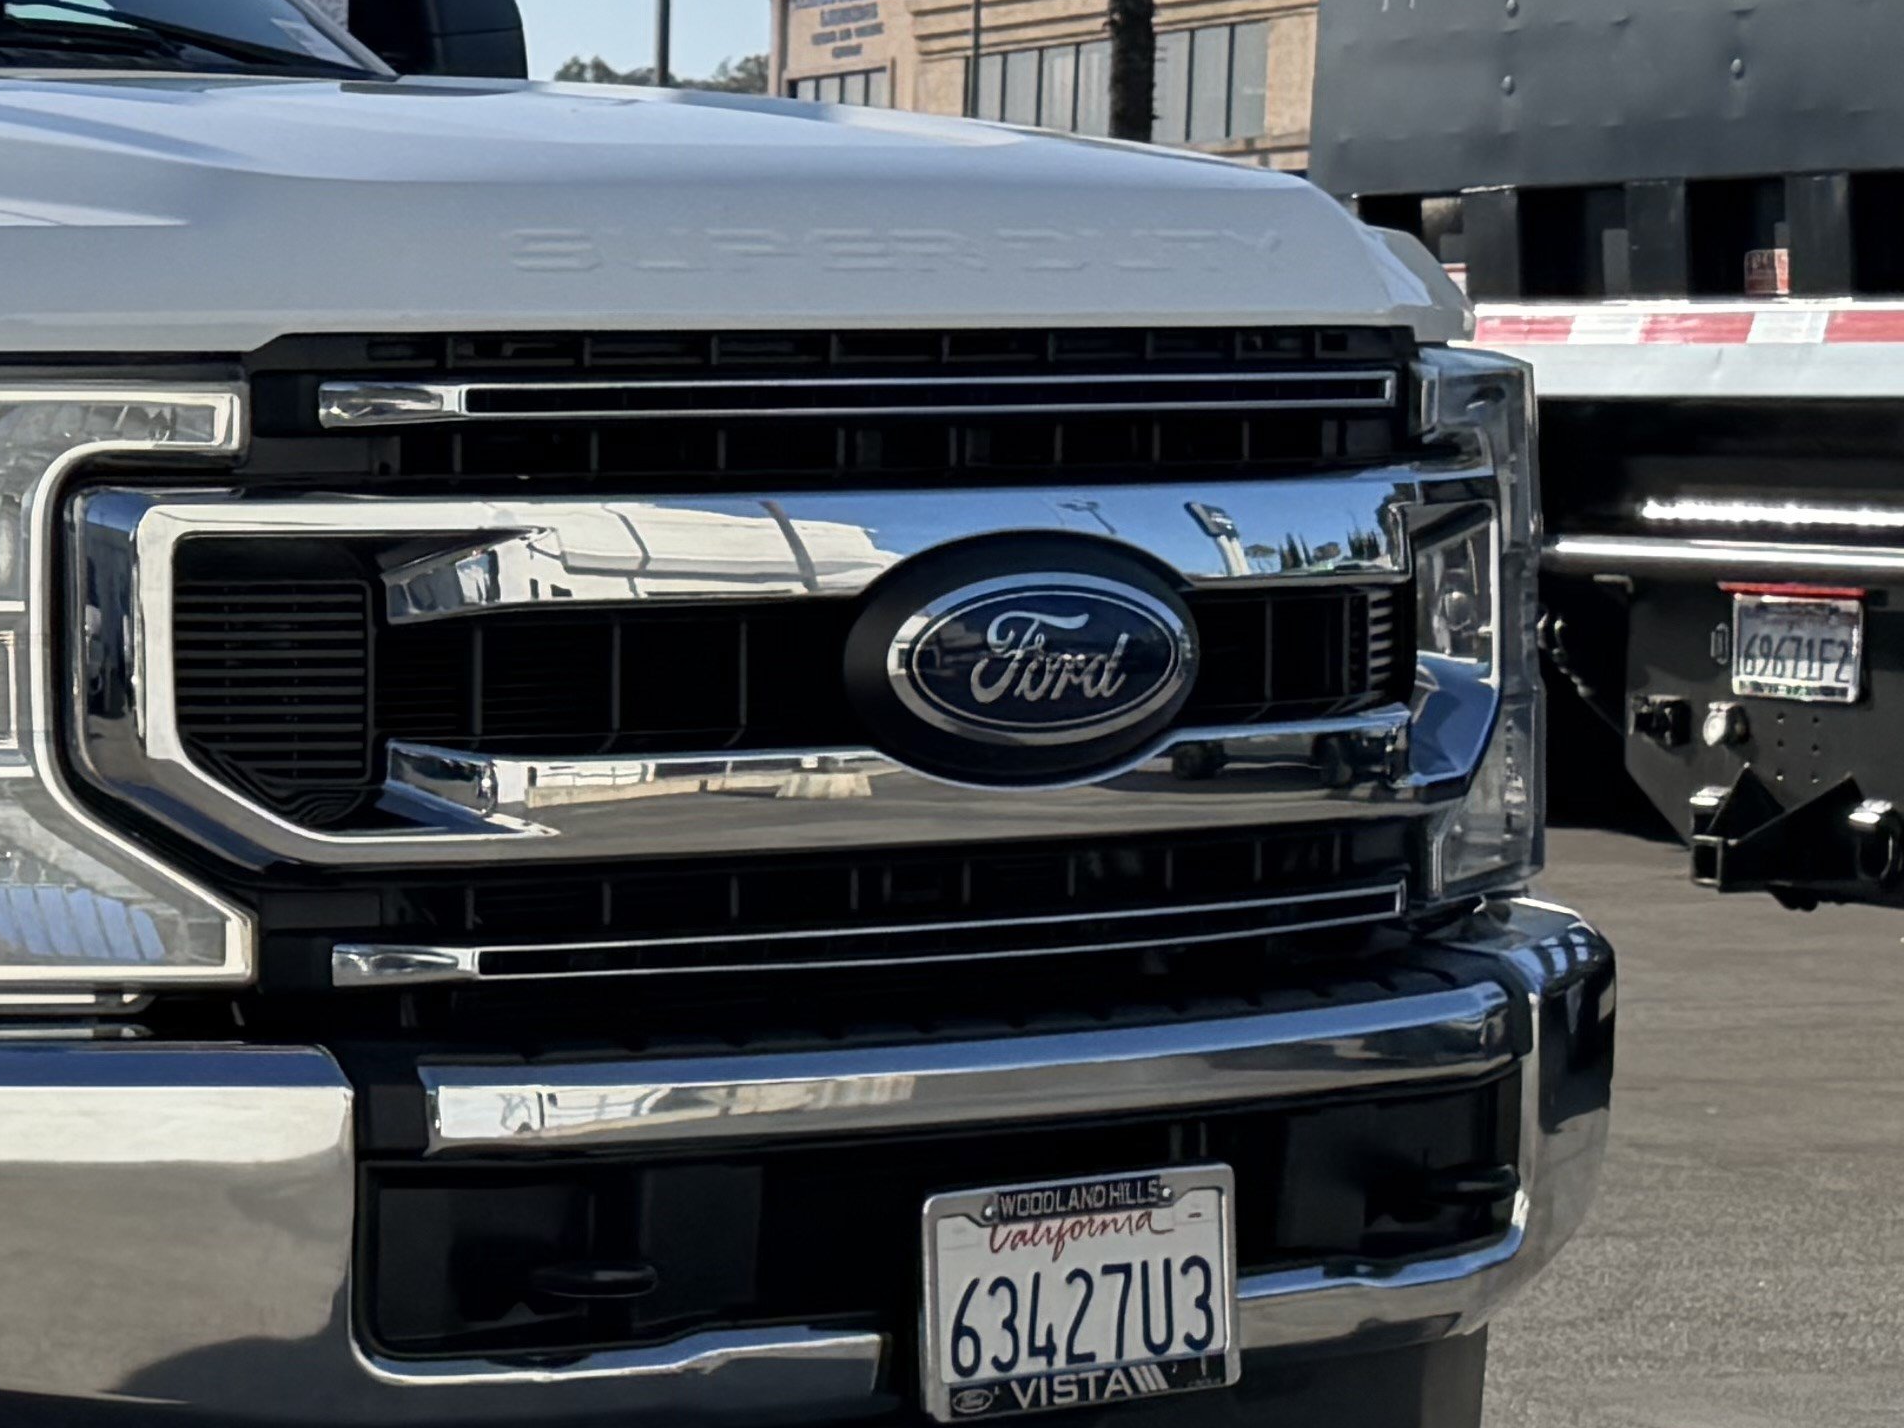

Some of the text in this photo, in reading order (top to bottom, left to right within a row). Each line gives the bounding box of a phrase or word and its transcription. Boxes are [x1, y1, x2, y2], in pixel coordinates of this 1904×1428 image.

[969, 610, 1131, 704] Ford
[999, 1178, 1160, 1218] WOODLAND HILLS
[989, 1209, 1175, 1263] California
[950, 1254, 1215, 1379] 63427U3
[1010, 1367, 1135, 1410] VISTA
